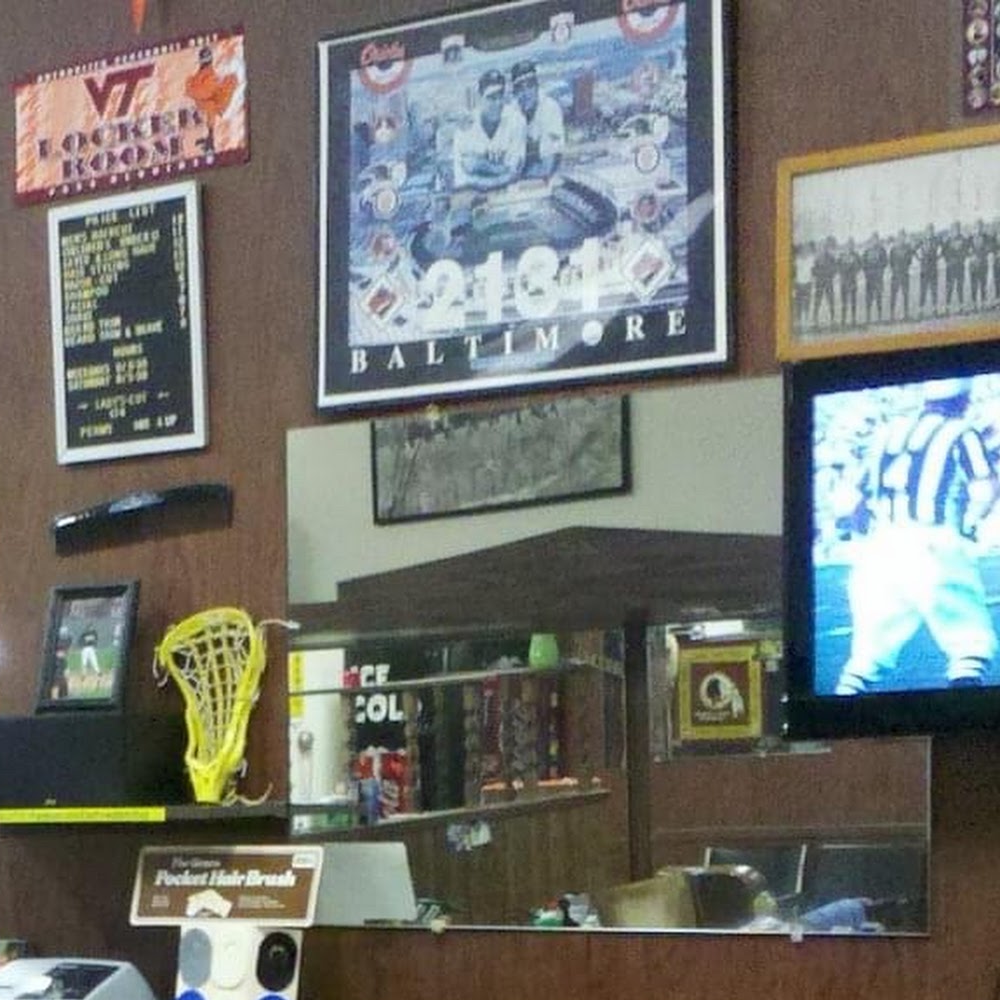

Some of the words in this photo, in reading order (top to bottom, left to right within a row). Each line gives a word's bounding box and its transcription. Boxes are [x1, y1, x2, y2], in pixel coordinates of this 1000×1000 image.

[83, 63, 155, 120] VT
[38, 108, 201, 160] LOCKER
[62, 136, 181, 178] ROOM
[350, 308, 686, 375] BALTIMORE
[350, 664, 391, 688] CE
[354, 692, 423, 724] COL
[154, 868, 208, 887] Pocket
[208, 868, 245, 887] Hair
[245, 868, 298, 887] Brush
